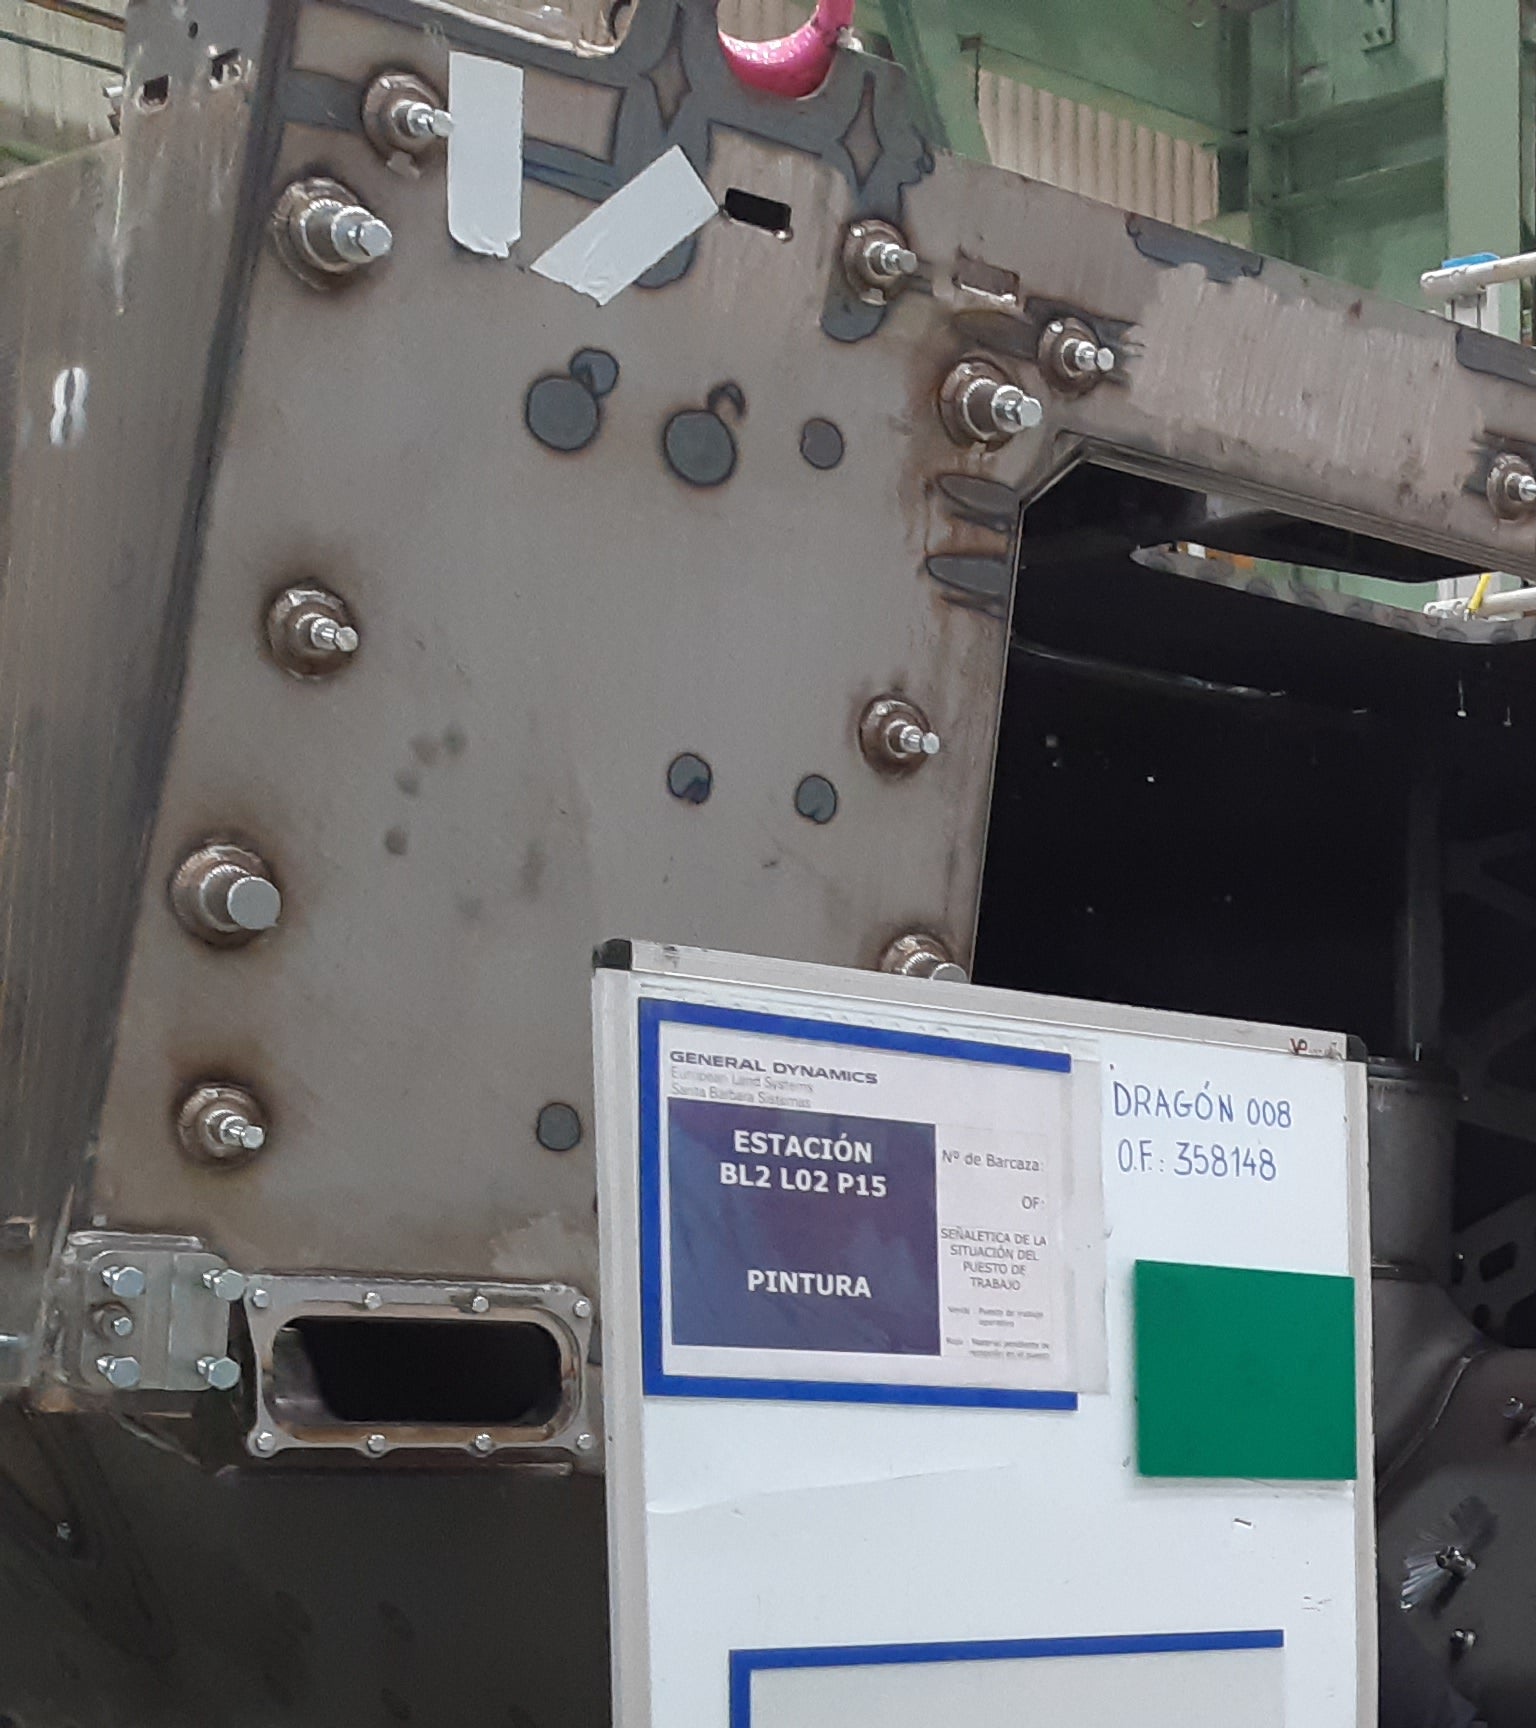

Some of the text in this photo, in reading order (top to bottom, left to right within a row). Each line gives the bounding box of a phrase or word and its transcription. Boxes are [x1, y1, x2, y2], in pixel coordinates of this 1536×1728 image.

[670, 1051, 878, 1084] GENERAL DYNAMICS
[1113, 1080, 1292, 1128] DRAGÓN 008
[734, 1129, 872, 1164] ESTACIÓN
[942, 1150, 1044, 1171] Nº de Barcaza:
[1173, 1141, 1277, 1181] 358148
[720, 1162, 887, 1198] BL2 L02 P15
[950, 1244, 1040, 1261] SITUACIÓN DEL
[1014, 1233, 1030, 1245] DE
[1034, 1235, 1047, 1246] LA
[963, 1261, 1026, 1276] PUESTO DE
[747, 1269, 872, 1298] PINTURA
[970, 1276, 1021, 1291] TRABAJO
